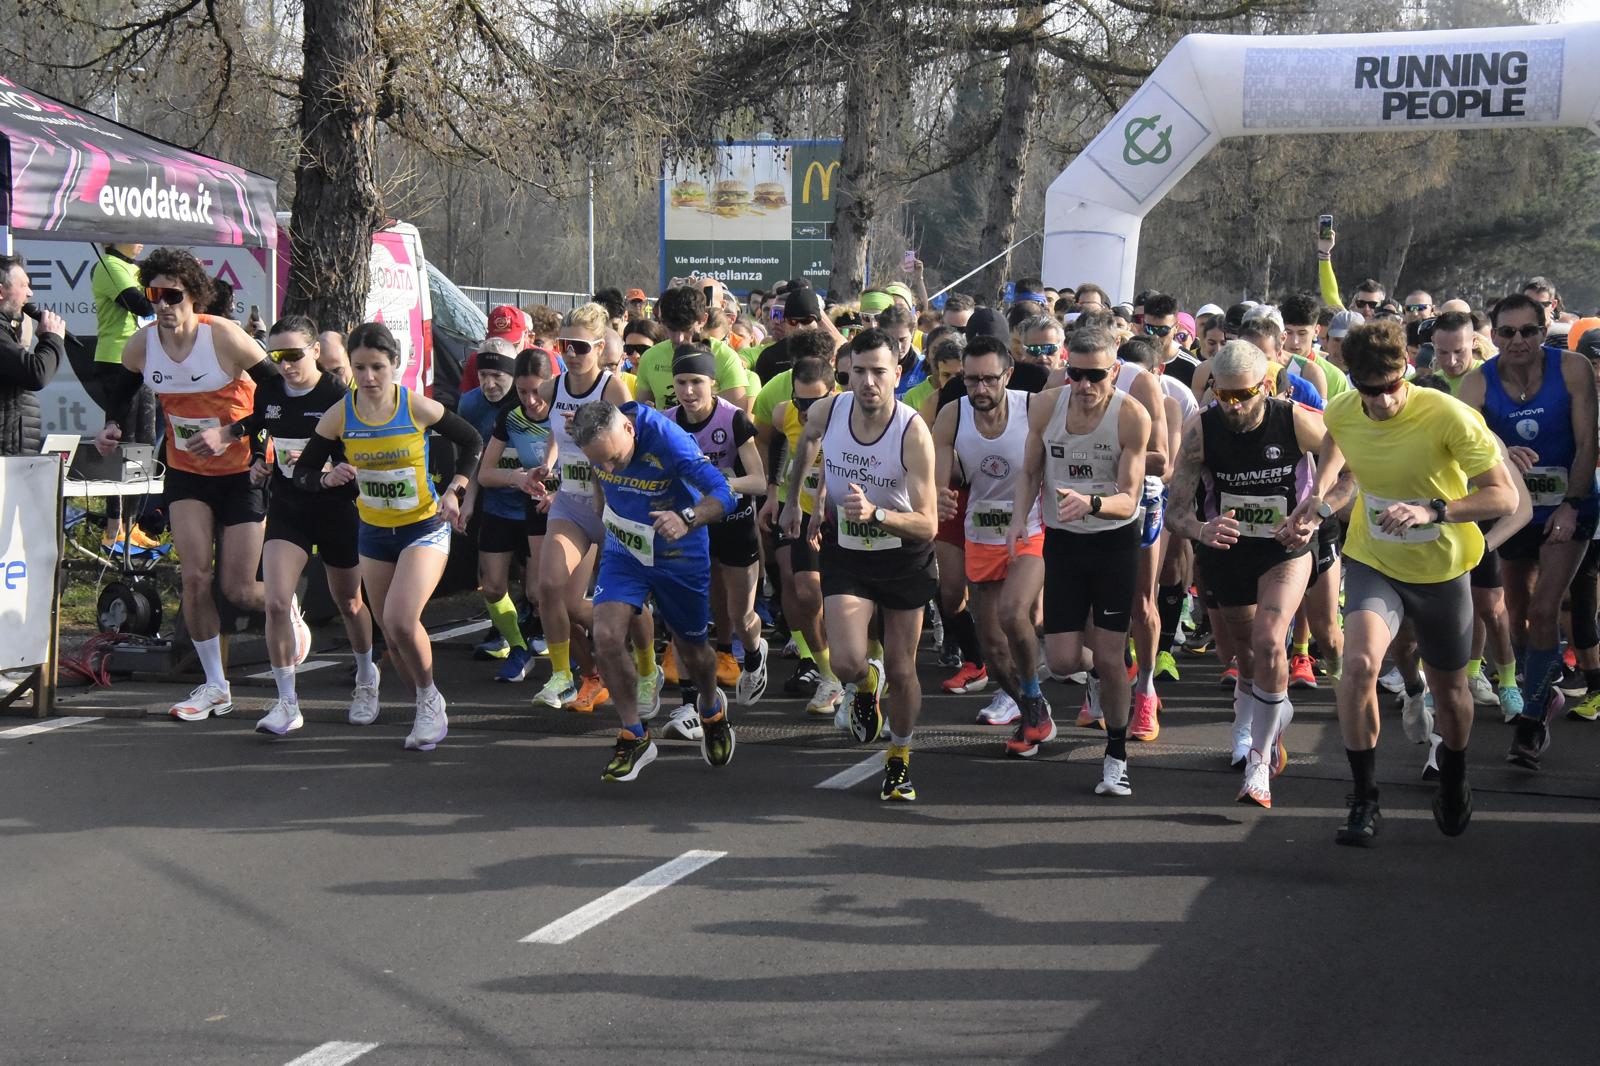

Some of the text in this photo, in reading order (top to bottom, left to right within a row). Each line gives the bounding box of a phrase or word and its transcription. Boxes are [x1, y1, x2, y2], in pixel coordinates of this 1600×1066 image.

[1355, 51, 1528, 89] RUNNING
[1382, 88, 1527, 120] PEOPLE
[100, 176, 214, 225] evodata.it
[742, 256, 779, 264] Piemonte
[691, 270, 763, 281] Castellanza
[1509, 407, 1545, 418] GIVOVA
[842, 452, 871, 468] TEAM
[568, 464, 592, 482] 1007
[1216, 464, 1294, 484] RUNNERS
[1229, 477, 1282, 487] LEGNANO
[366, 480, 407, 499] 10082
[726, 506, 752, 522] PRO
[1228, 507, 1273, 525] 0022
[608, 522, 643, 551] 10079
[847, 520, 888, 537] 10062
